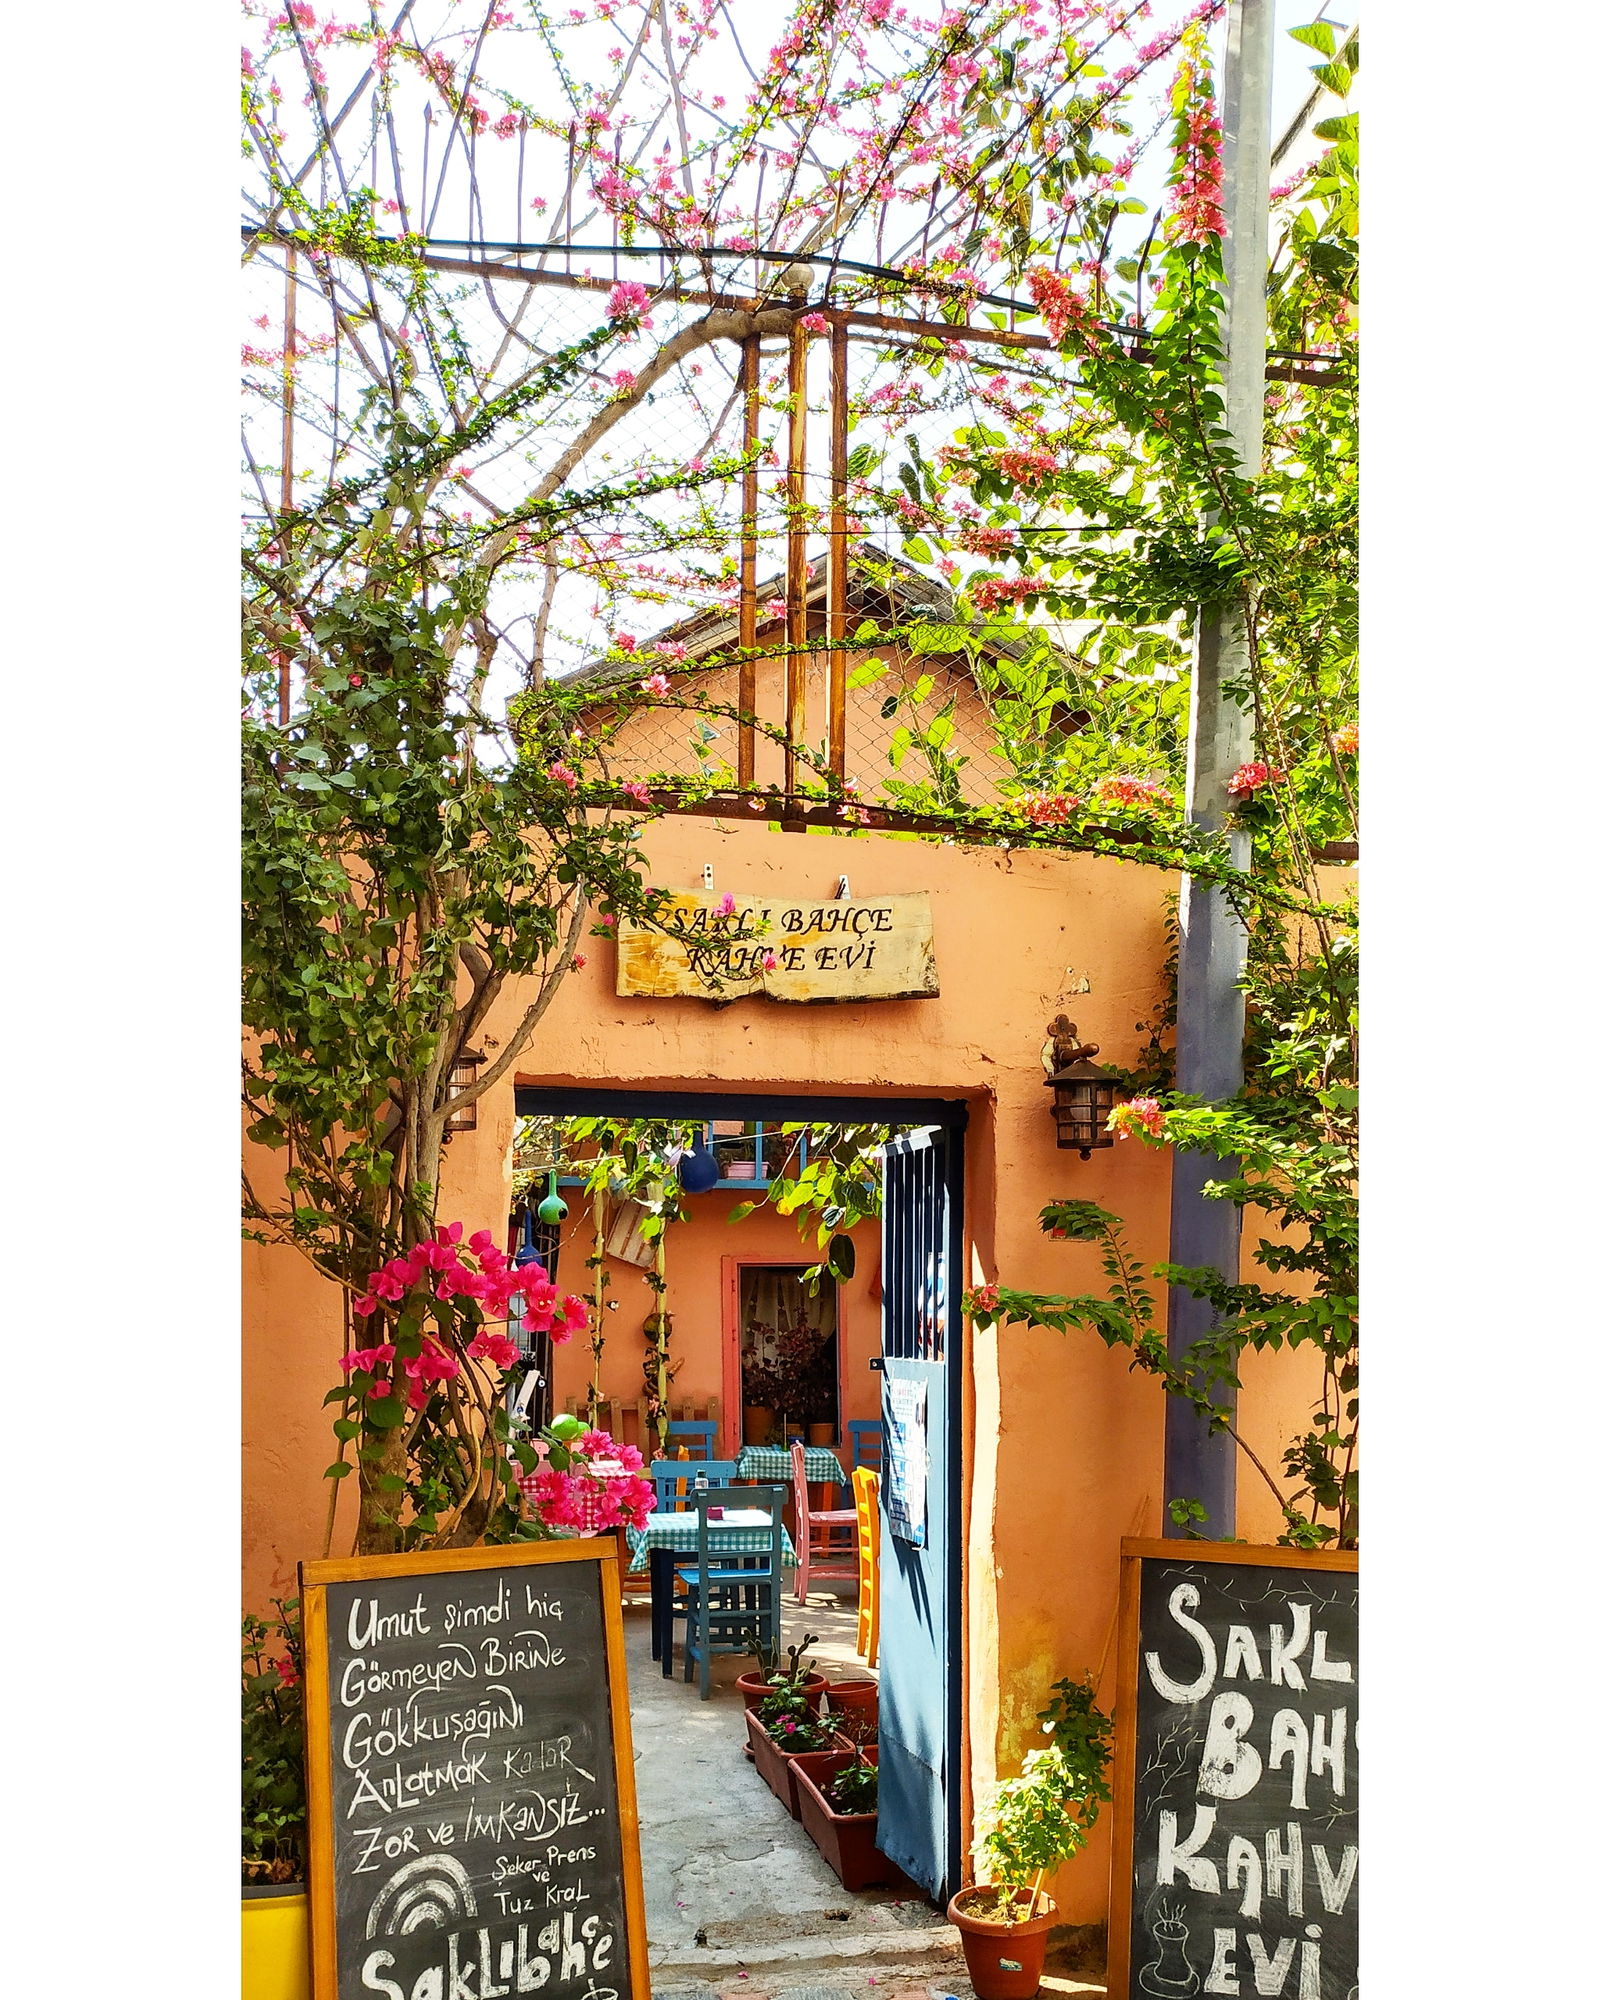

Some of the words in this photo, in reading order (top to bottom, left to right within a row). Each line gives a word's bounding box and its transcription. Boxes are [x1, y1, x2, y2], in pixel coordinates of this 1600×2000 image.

[781, 907, 893, 941] BAHÇE
[815, 940, 876, 970] EVİ
[347, 1593, 431, 1651] Umut
[526, 1584, 565, 1621] hiç
[1197, 1691, 1359, 1810] BAH
[427, 1822, 456, 1846] ve
[491, 1855, 541, 1887] Şeker
[546, 1845, 597, 1866] Prens
[532, 1870, 550, 1882] ve
[493, 1891, 534, 1916] Tuz
